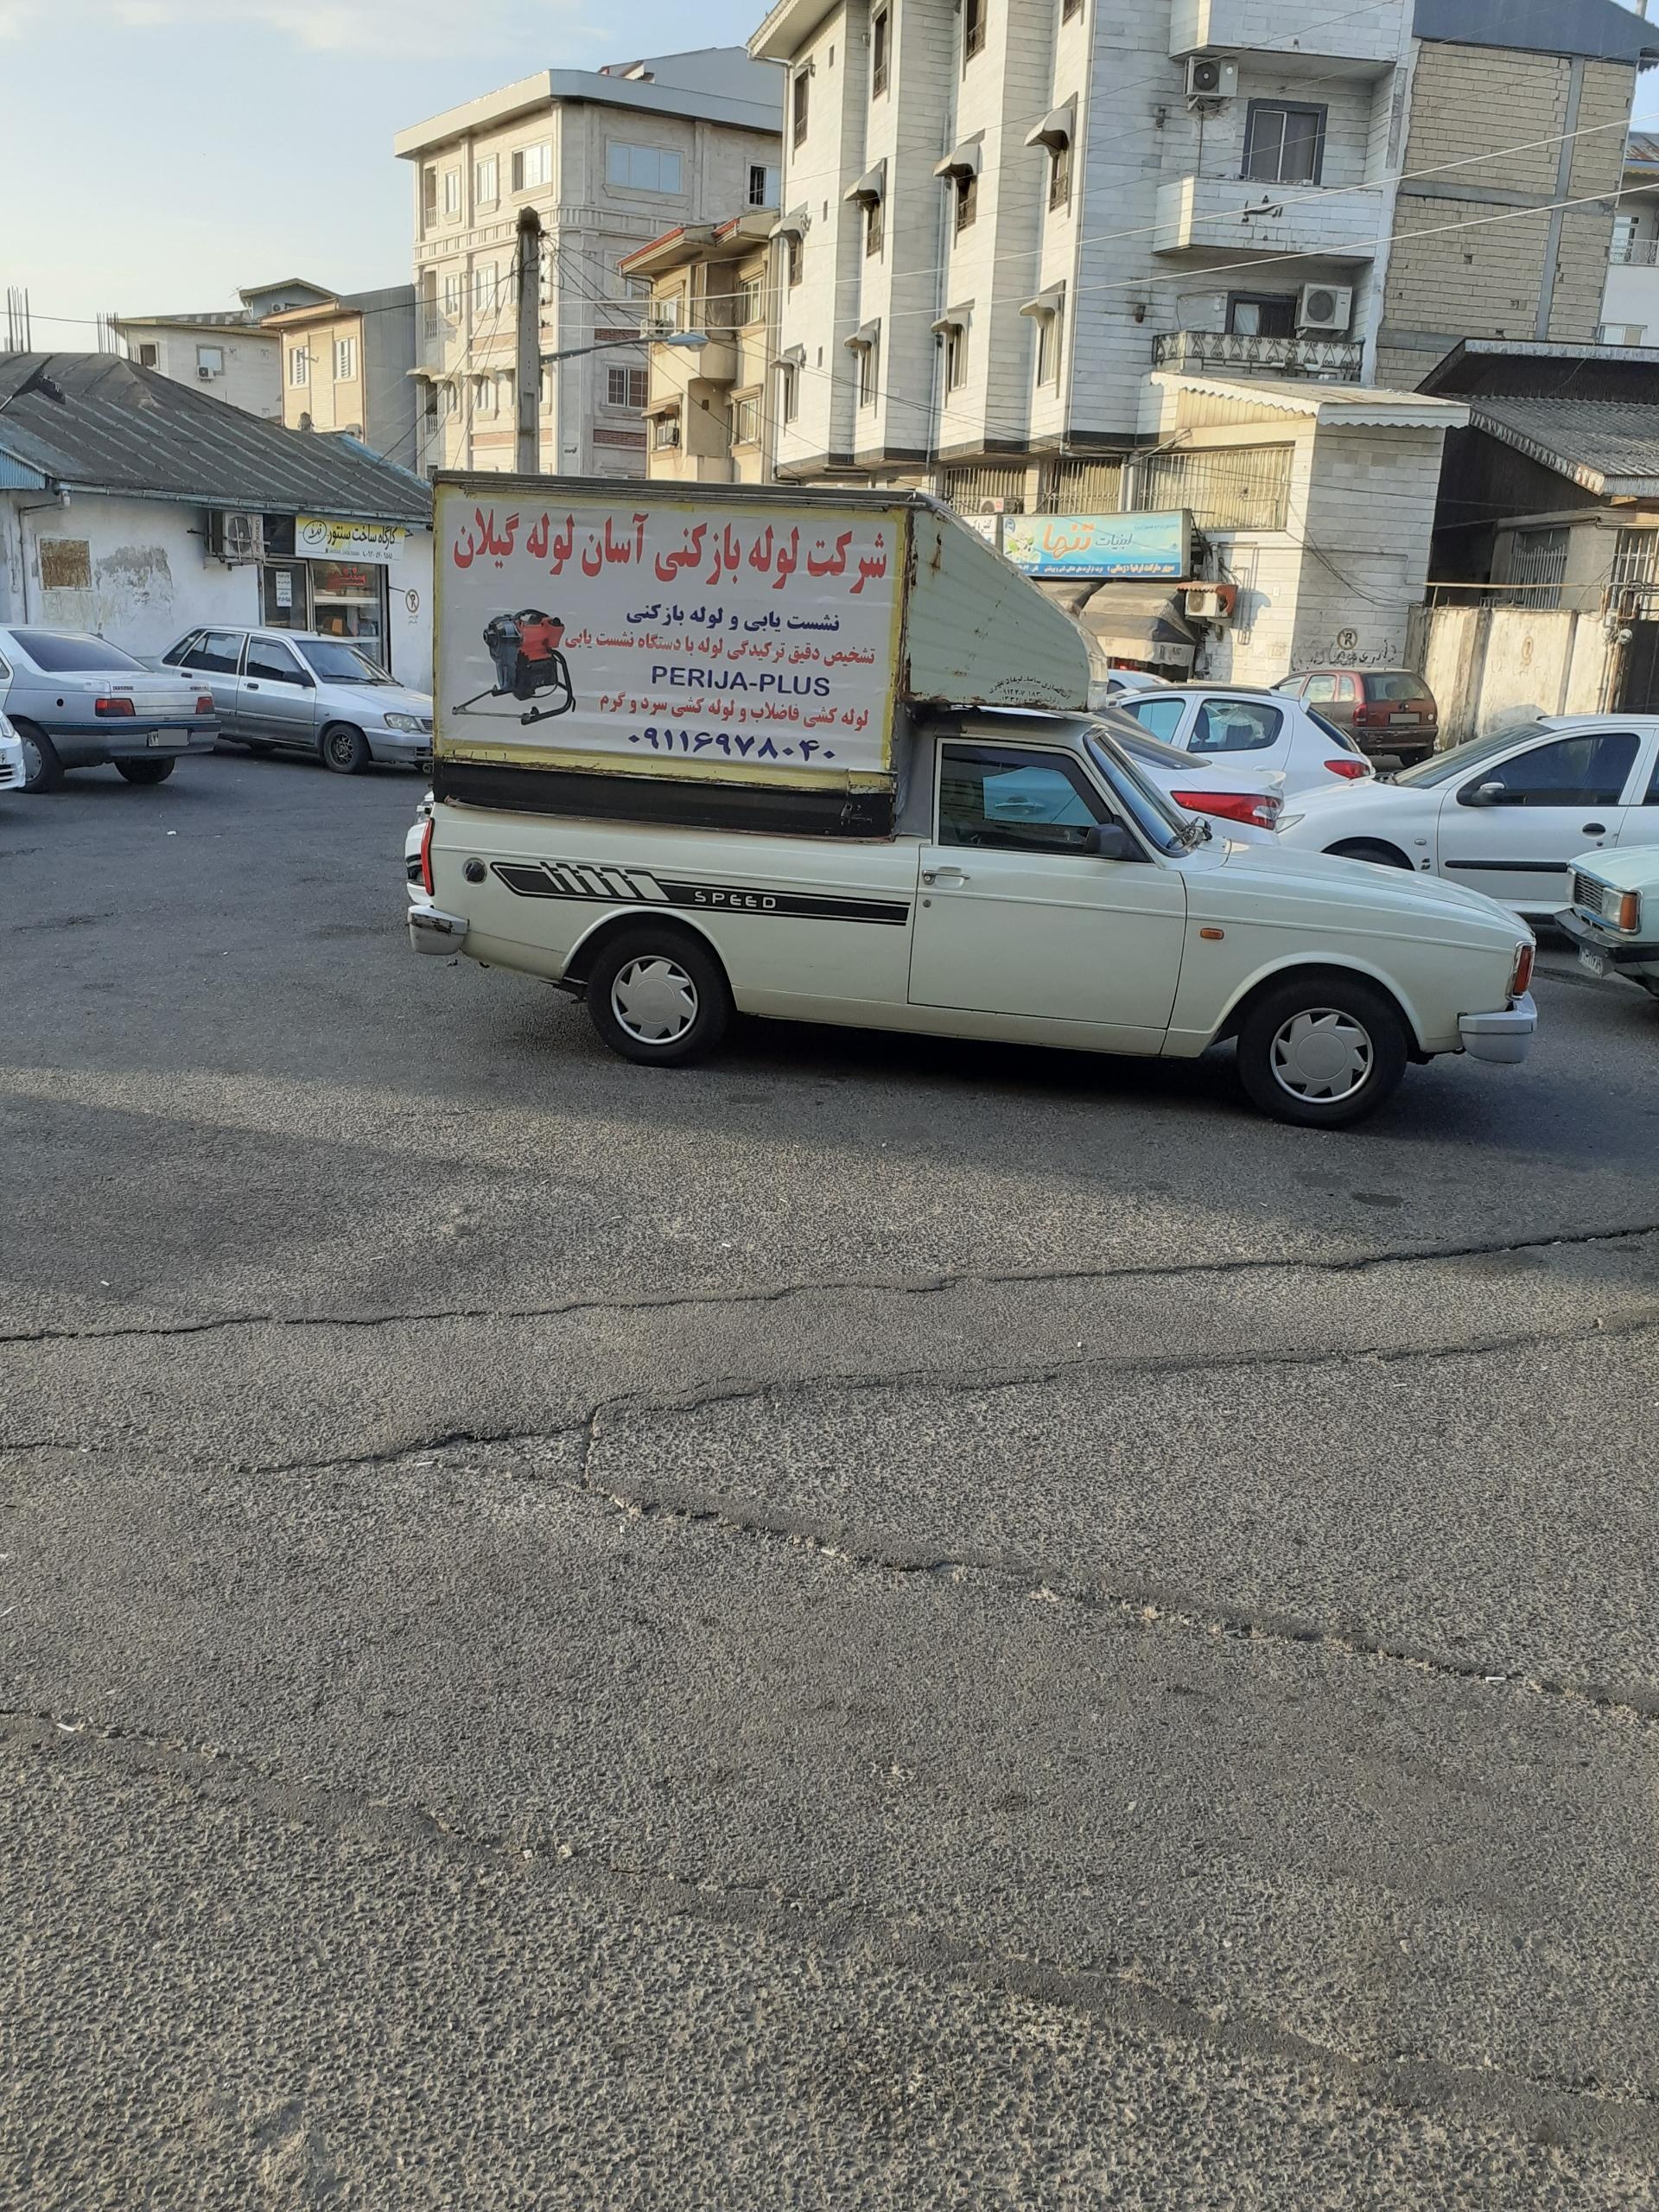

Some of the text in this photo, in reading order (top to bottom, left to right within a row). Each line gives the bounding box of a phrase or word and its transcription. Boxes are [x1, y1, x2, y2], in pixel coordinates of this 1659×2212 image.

[327, 524, 351, 546] سنتور
[352, 524, 377, 543] ساخت
[378, 525, 398, 550] کارگاه
[453, 506, 519, 569] گیلان
[526, 511, 575, 575] لوله
[581, 512, 649, 577] آسان
[1095, 532, 1134, 550] لبنیات
[748, 524, 800, 589] لوله
[807, 530, 887, 594] شرکت
[690, 606, 723, 629] لوله
[728, 614, 739, 631] و
[744, 610, 781, 632] یابی
[787, 613, 840, 632] نشست
[564, 628, 876, 667] تشخیص دقیق ترکیدگی لوله با دستگاه نشست یابی
[652, 665, 830, 696] PERIJA-PLUS
[600, 691, 869, 732] لوله کشی فاضلاب و لوله کشی سرد و گرم
[627, 727, 836, 762] ۰۹۱۱۶۹۷۸۰۴۰
[694, 890, 777, 909] SPEED
